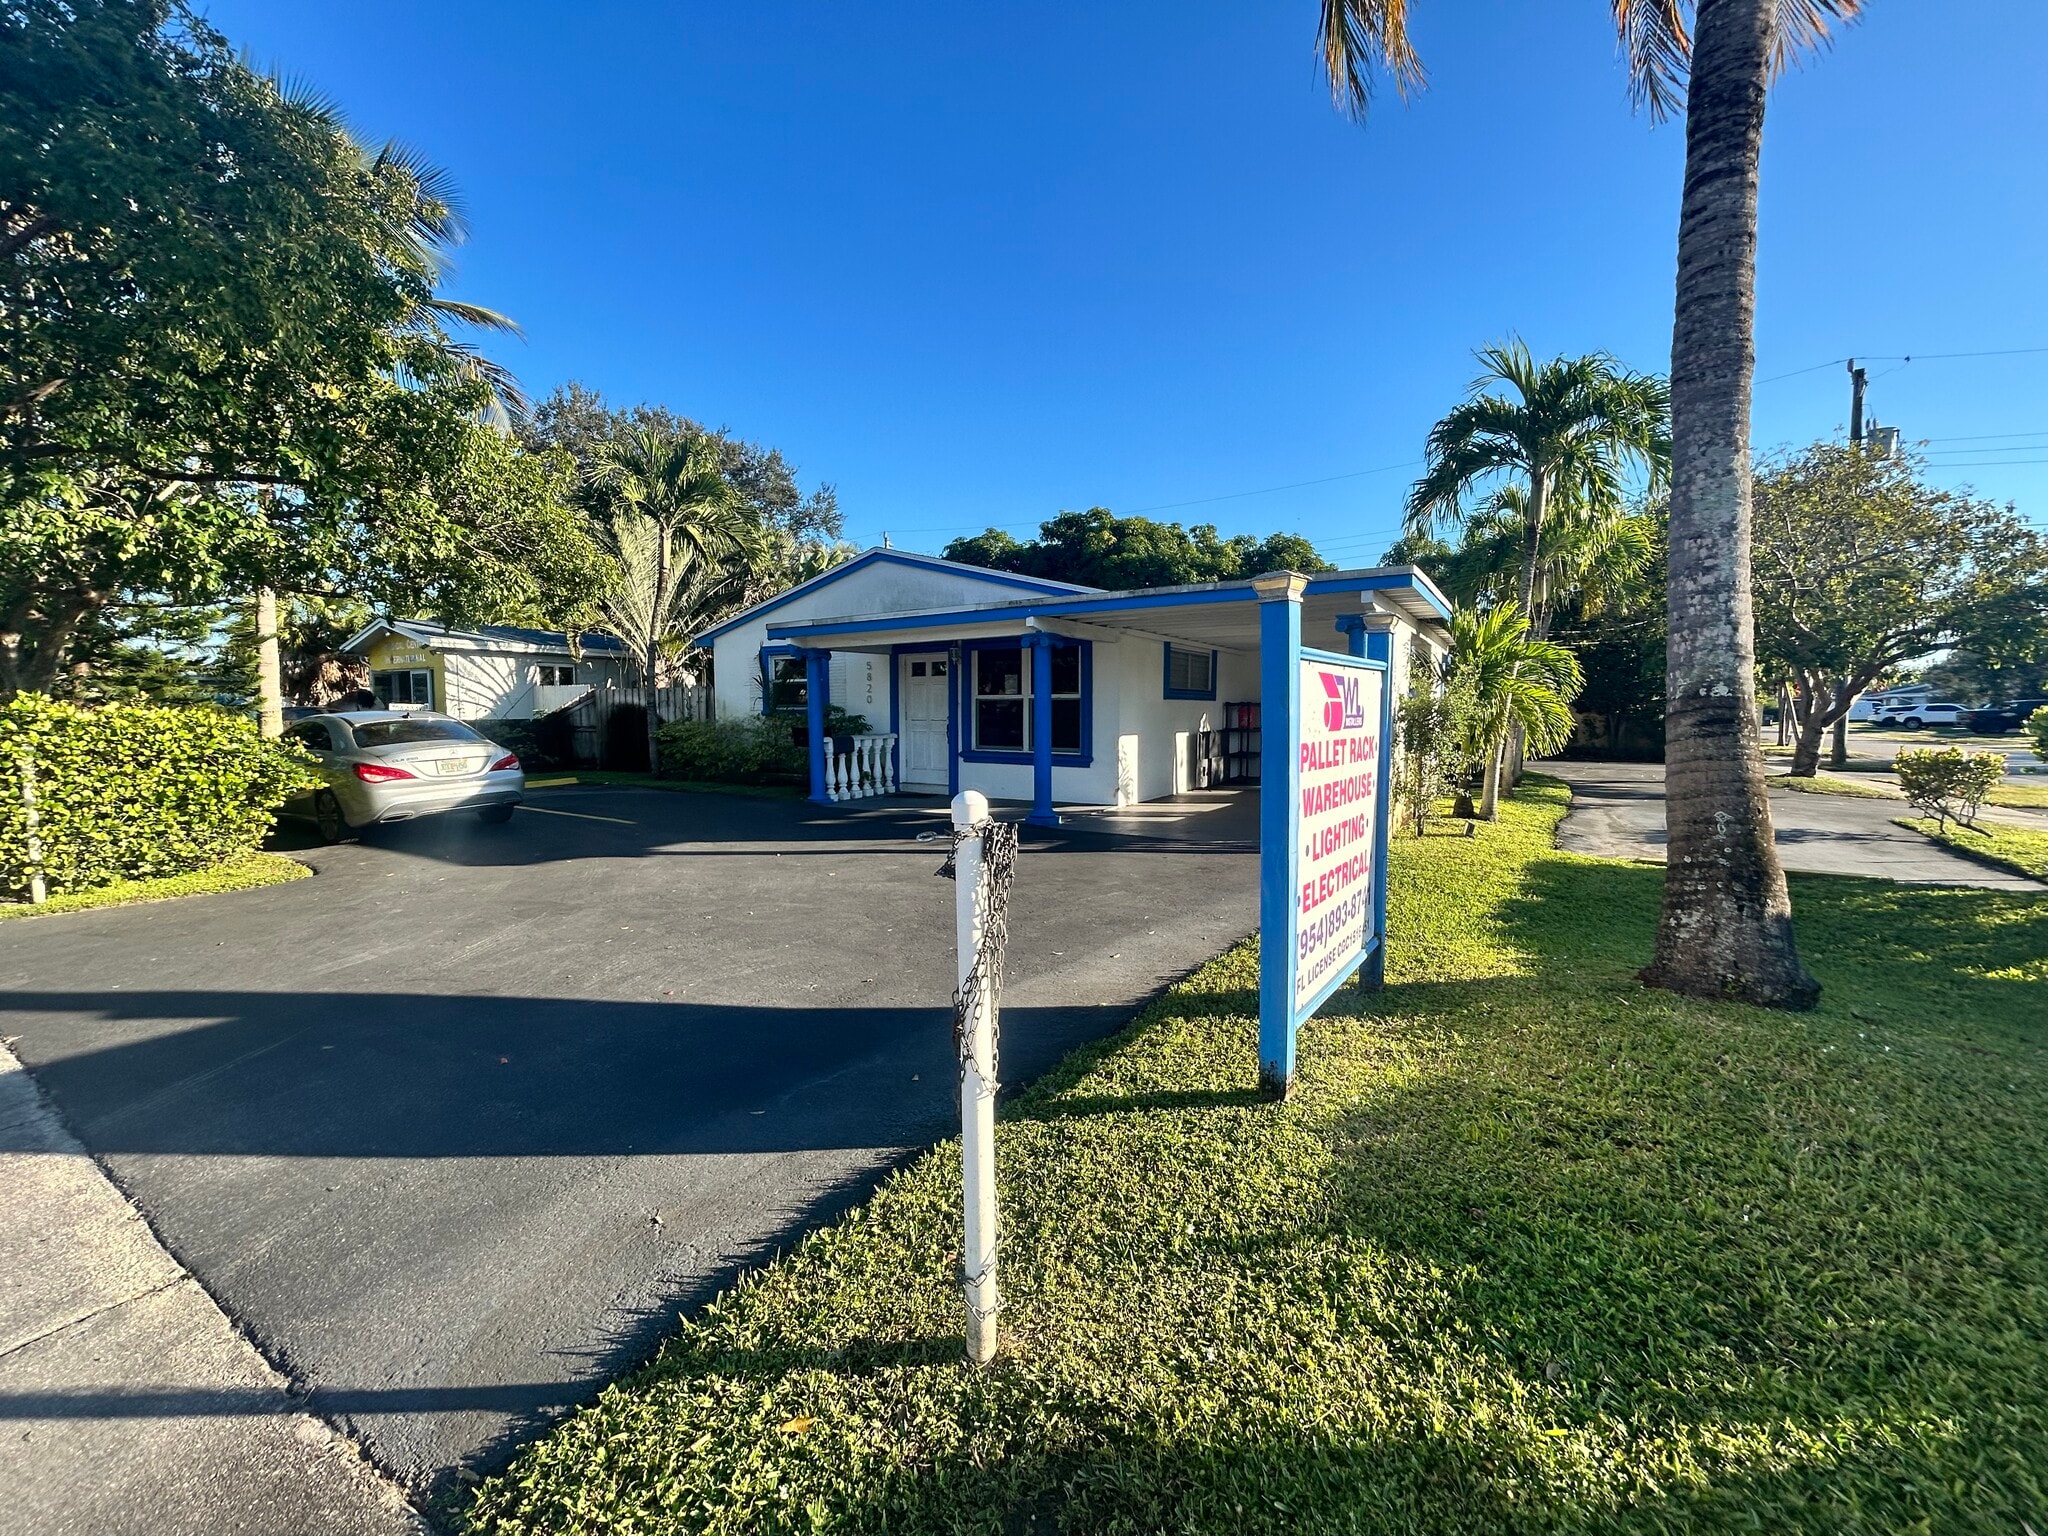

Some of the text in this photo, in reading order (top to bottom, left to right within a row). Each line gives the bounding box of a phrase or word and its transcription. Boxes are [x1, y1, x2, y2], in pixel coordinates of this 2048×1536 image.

[1300, 735, 1375, 773] PALLET RACK
[1302, 772, 1372, 818] WAREHOUSE
[1312, 813, 1365, 862] LIGHTING
[1302, 849, 1369, 914] ELECTRICAL
[1296, 974, 1306, 995] FL
[1308, 947, 1337, 985] LICENSE
